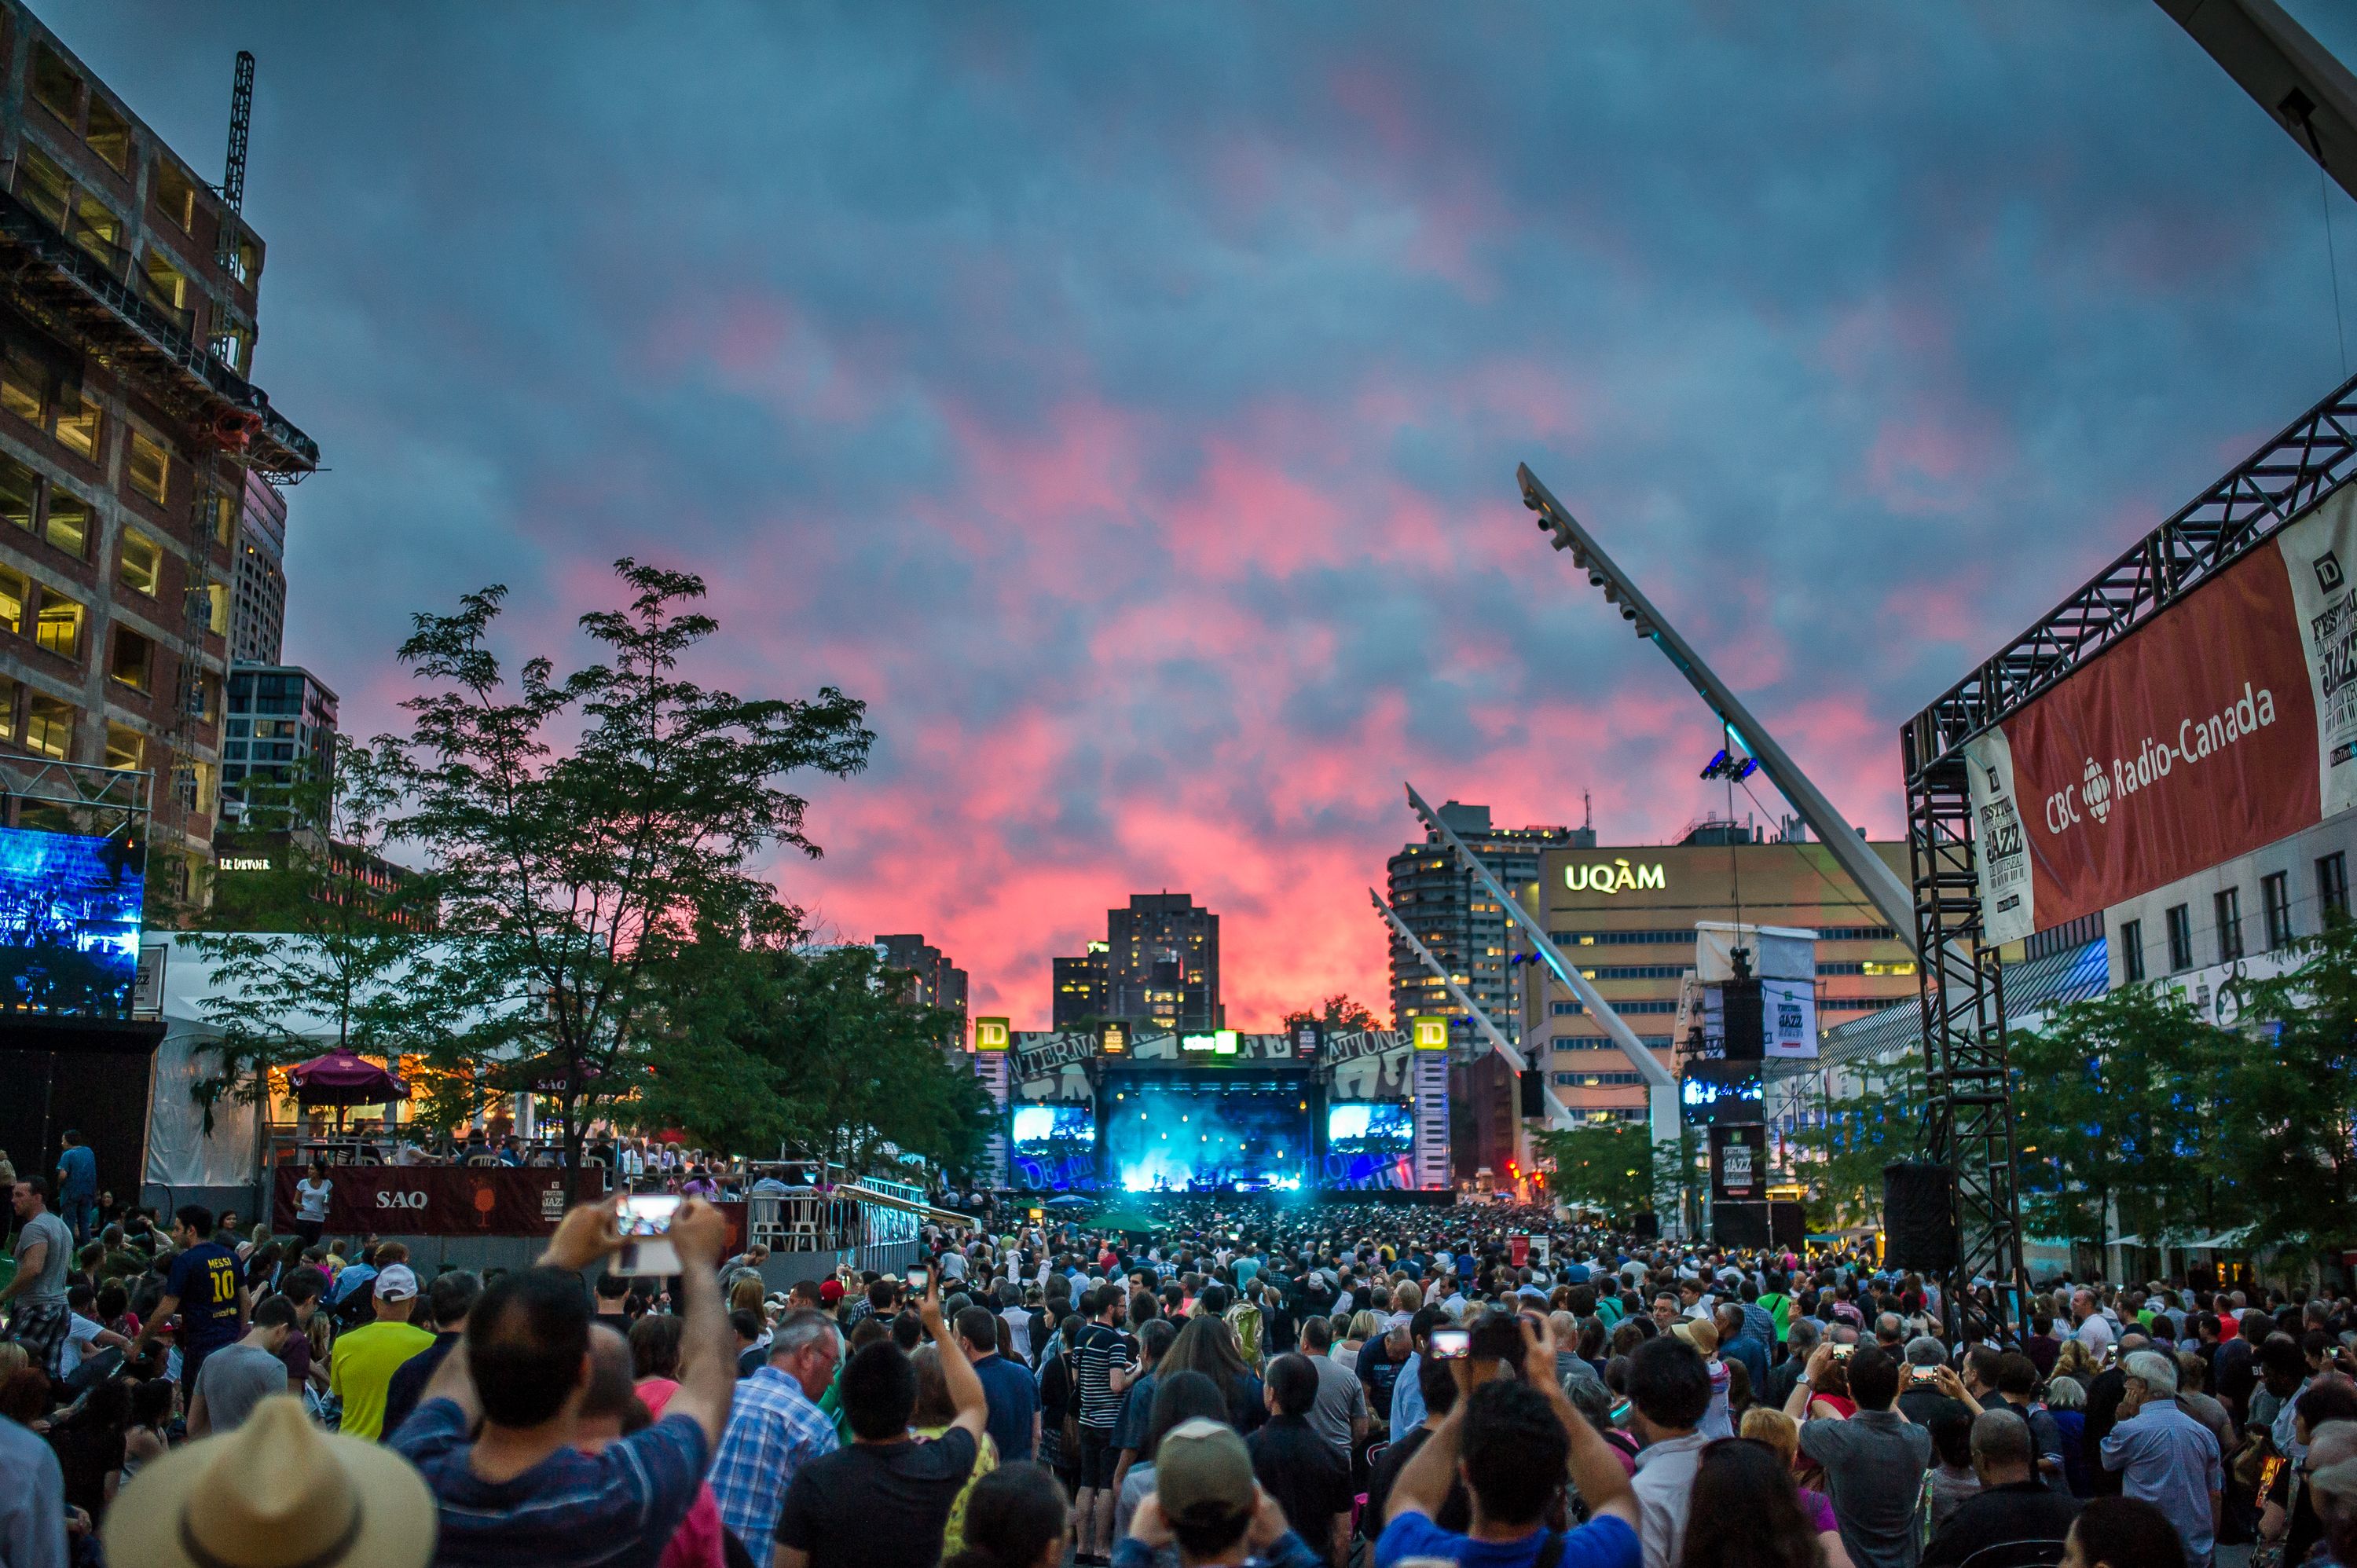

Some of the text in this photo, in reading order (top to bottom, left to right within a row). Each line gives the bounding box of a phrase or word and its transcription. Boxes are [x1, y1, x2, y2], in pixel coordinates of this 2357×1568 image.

[2317, 559, 2340, 586] TD
[2046, 681, 2276, 834] CBC Radio-Canada
[1987, 822, 2023, 865] JAZZ
[1564, 858, 1666, 894] UQÀM
[978, 1024, 1006, 1045] TD
[1417, 1023, 1445, 1044] TD
[1724, 1157, 1752, 1173] JAZZ
[376, 1191, 428, 1210] SAQ
[207, 1257, 232, 1269] MESSI
[210, 1269, 235, 1302] 10
